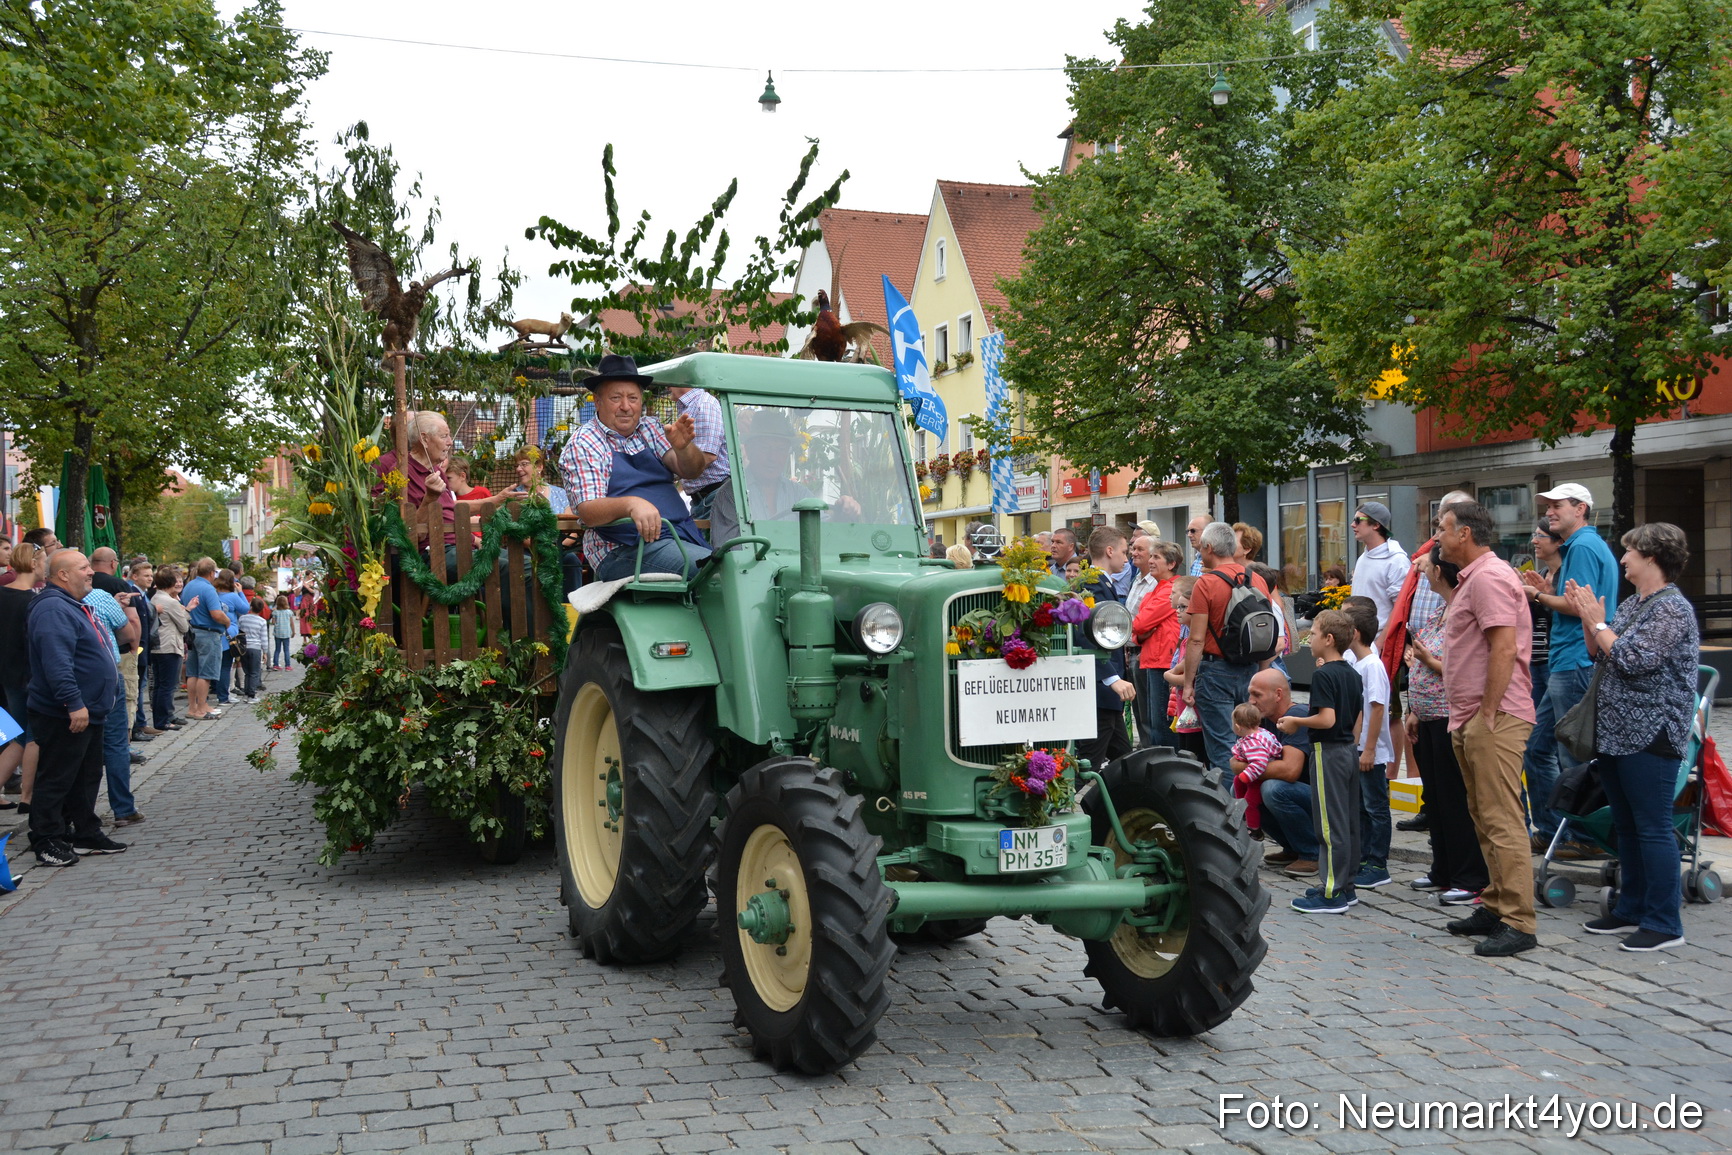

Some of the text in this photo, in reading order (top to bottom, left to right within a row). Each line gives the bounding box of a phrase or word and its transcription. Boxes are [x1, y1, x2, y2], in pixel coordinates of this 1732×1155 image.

[1041, 477, 1049, 509] INO
[964, 675, 1086, 696] GEFLÜGELZUCHTVEREIN
[996, 707, 1057, 724] NEUMARKT
[1014, 831, 1038, 850] NM
[1005, 849, 1054, 870] PM 35
